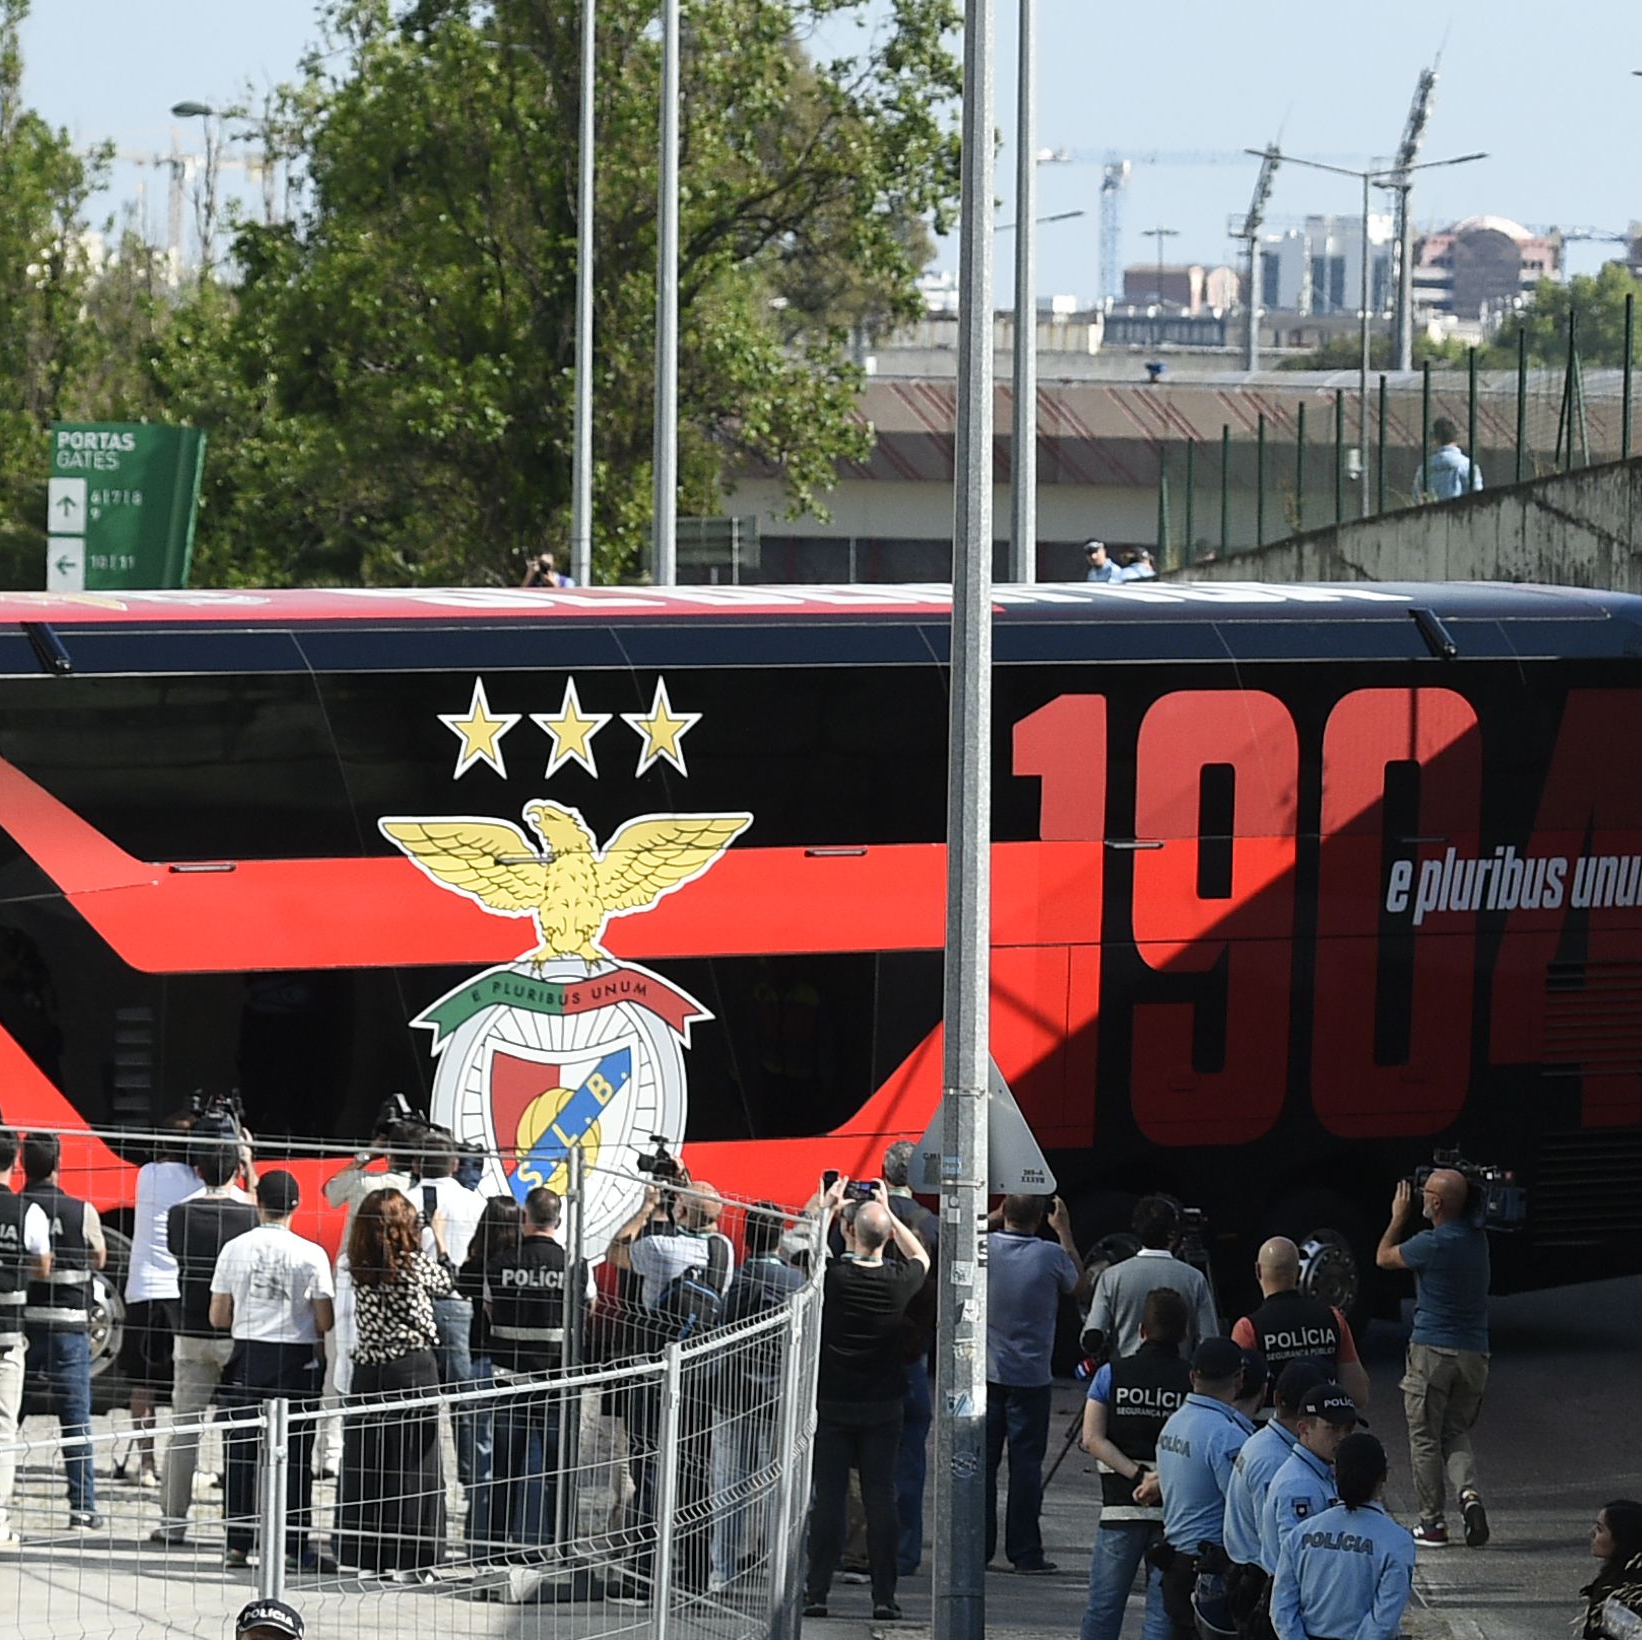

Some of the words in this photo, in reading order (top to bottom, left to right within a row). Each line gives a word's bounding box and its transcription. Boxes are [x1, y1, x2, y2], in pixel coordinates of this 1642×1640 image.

[57, 431, 136, 450] PORTAS
[57, 450, 120, 470] GATES
[1386, 860, 1413, 913] e
[1412, 846, 1568, 926] pluribus
[472, 990, 481, 1002] E
[492, 981, 581, 1006] PLURIBUS
[591, 981, 647, 999] UNUM
[501, 1265, 564, 1289] POLÍCI
[1264, 1326, 1336, 1351] POLÍCIA
[1116, 1387, 1181, 1408] POLÍCI
[1324, 1396, 1356, 1409] POLÍC
[1160, 1434, 1191, 1459] OLÍCIA
[1300, 1531, 1374, 1556] POLÍCIA
[243, 1607, 294, 1628] POLÍCIA
